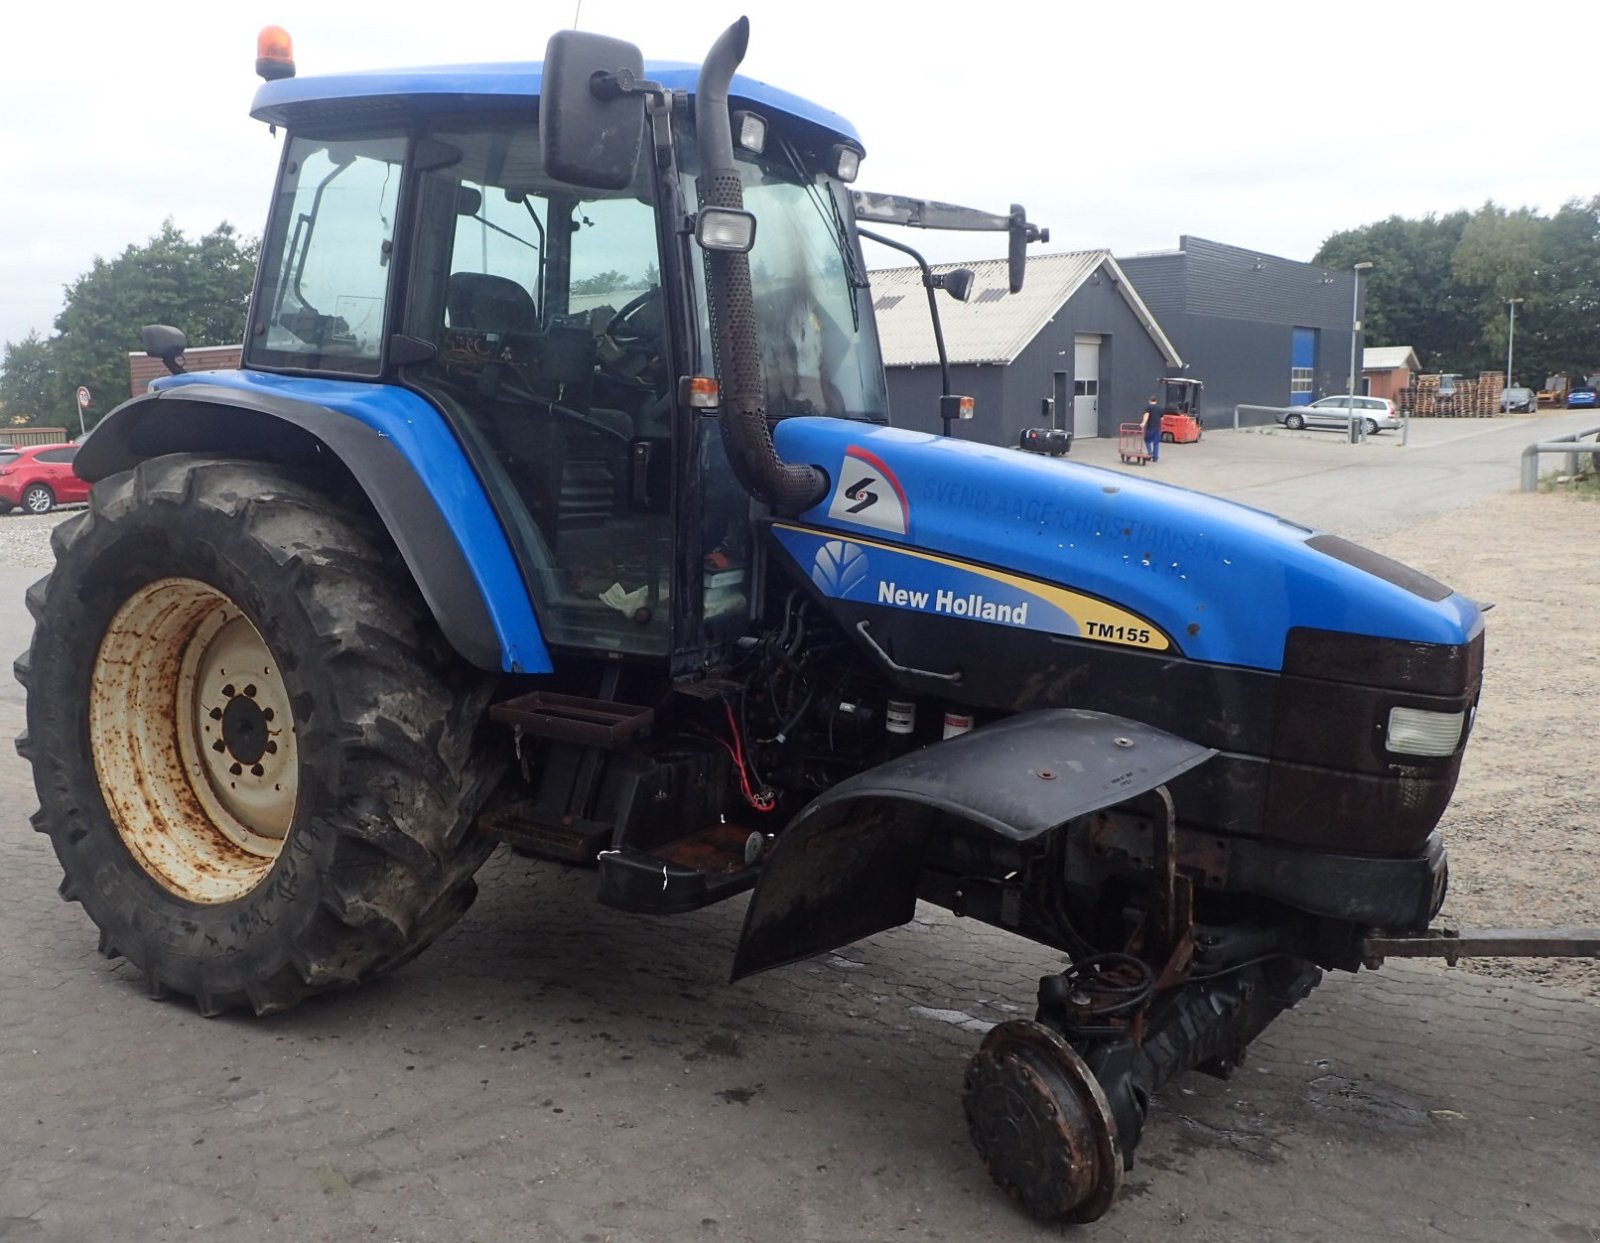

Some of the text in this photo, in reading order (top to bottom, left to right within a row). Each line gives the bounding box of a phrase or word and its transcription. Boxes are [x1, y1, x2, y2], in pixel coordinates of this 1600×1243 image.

[878, 581, 1028, 625] New Holland
[1086, 621, 1150, 644] TM155
